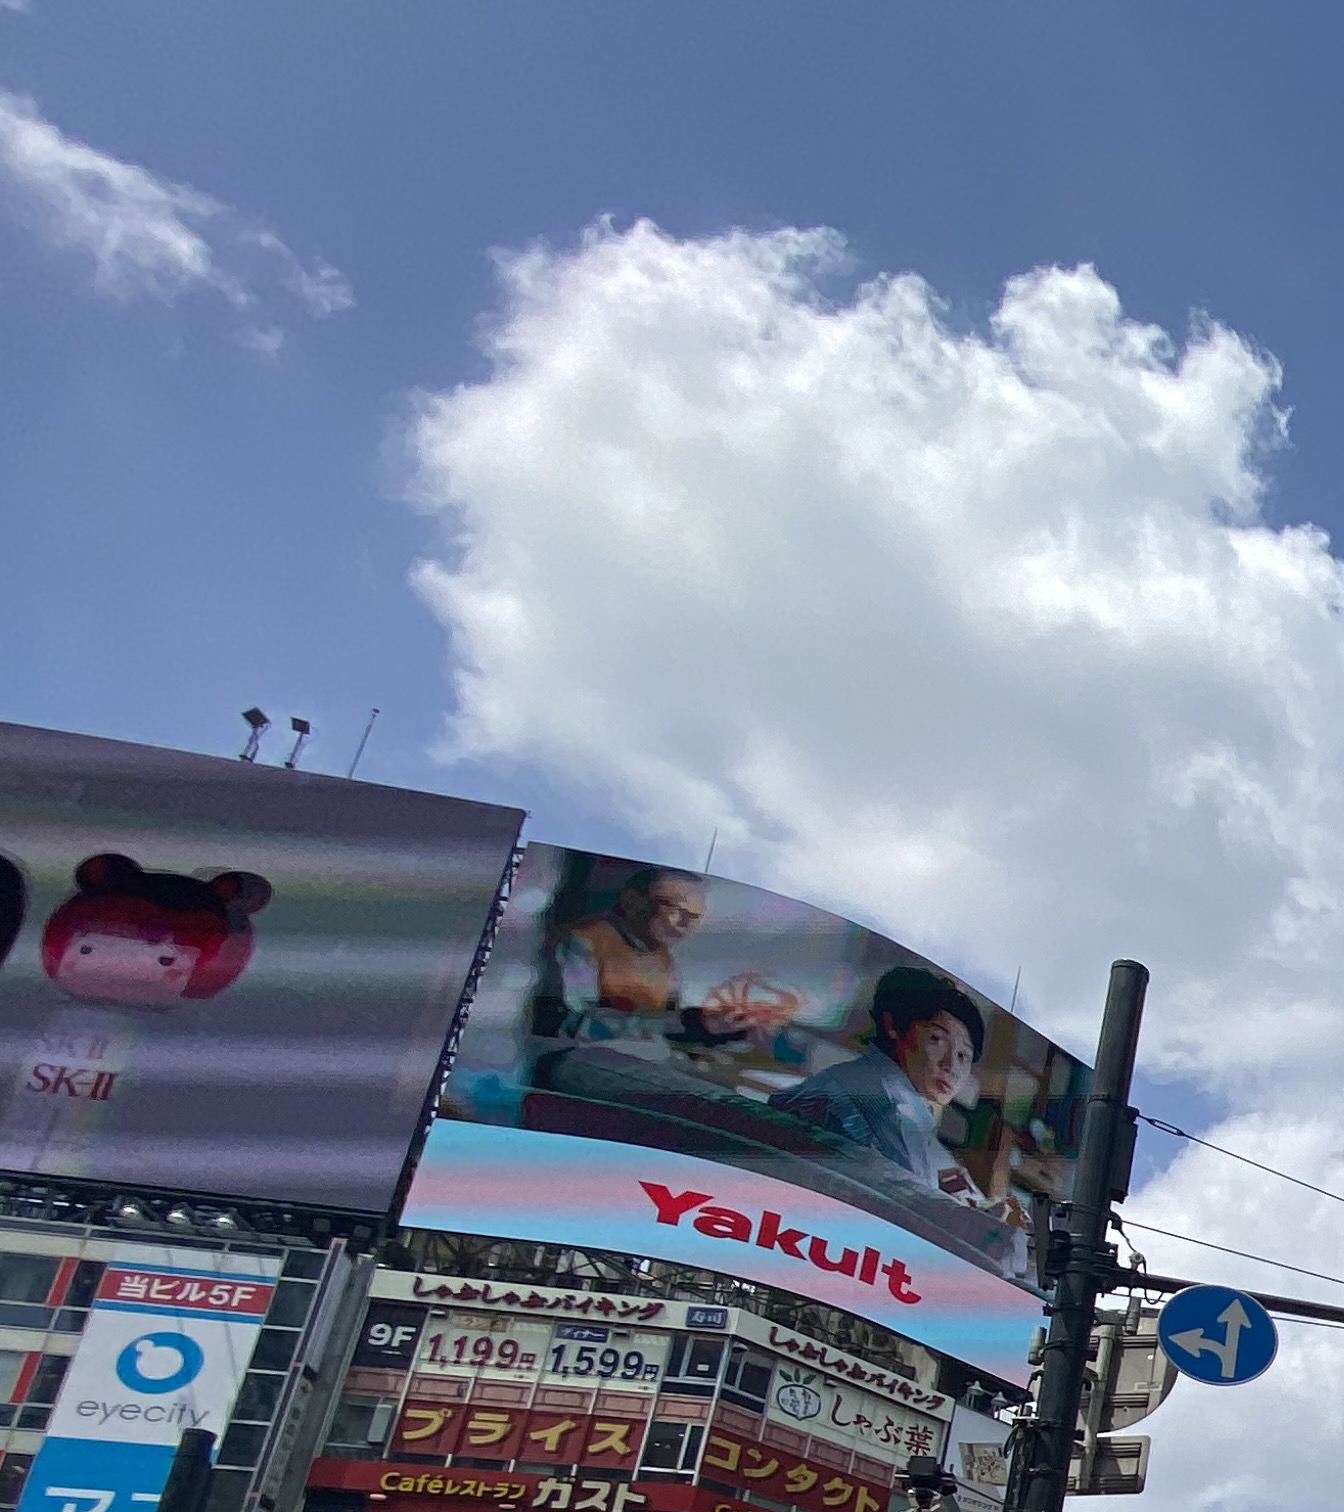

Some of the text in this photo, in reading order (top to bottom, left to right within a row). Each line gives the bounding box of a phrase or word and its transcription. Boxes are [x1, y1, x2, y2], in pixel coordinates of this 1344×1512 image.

[637, 1181, 922, 1305] Yakult
[117, 1275, 256, 1307] 当ビル5F
[367, 1323, 418, 1348] 9F
[428, 1333, 537, 1368] 1,199円
[551, 1344, 661, 1380] 1,599円
[77, 1400, 208, 1427] eyecity
[831, 1394, 934, 1456] しゃぶ葉
[402, 1408, 632, 1455] プライス
[531, 1477, 647, 1512] ガスト
